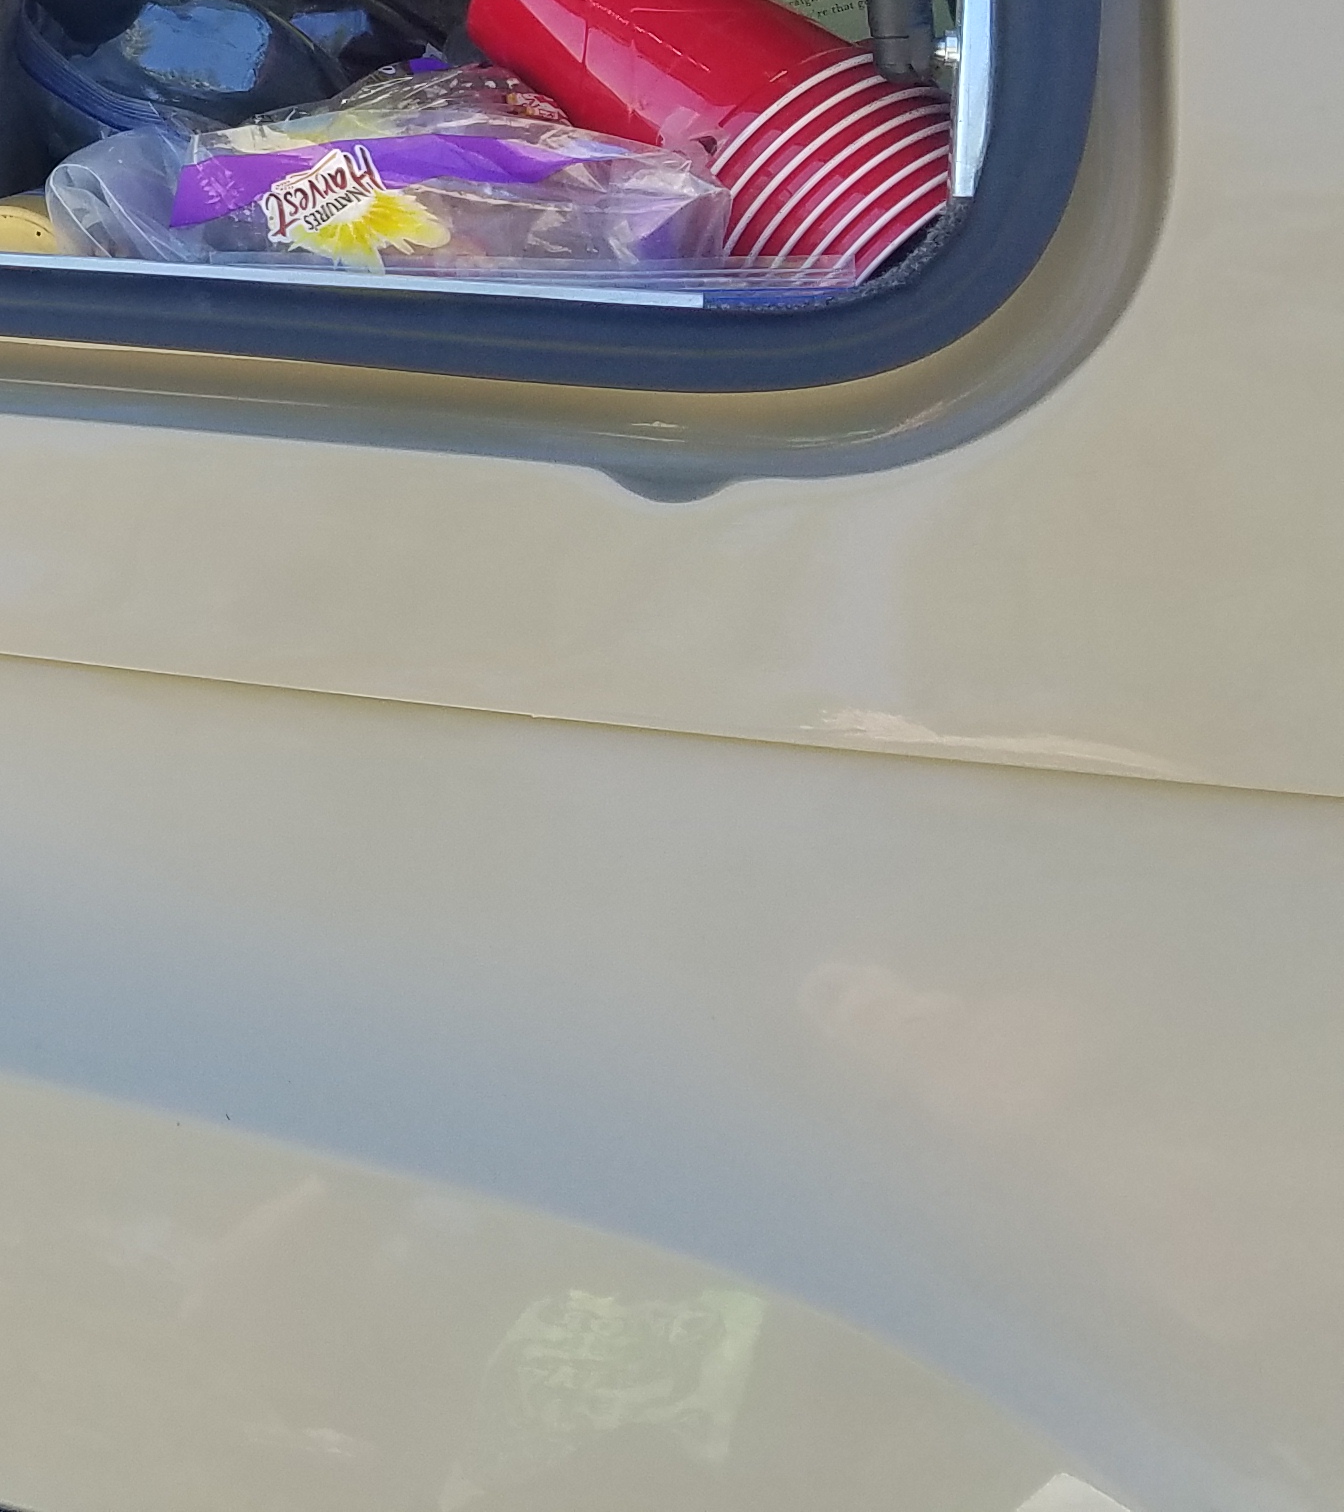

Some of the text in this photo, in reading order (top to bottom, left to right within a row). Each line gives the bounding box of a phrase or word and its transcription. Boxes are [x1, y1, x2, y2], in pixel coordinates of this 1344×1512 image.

[832, 2, 854, 13] that
[265, 146, 385, 237] Harvest
[303, 182, 372, 231] NATURE'S
